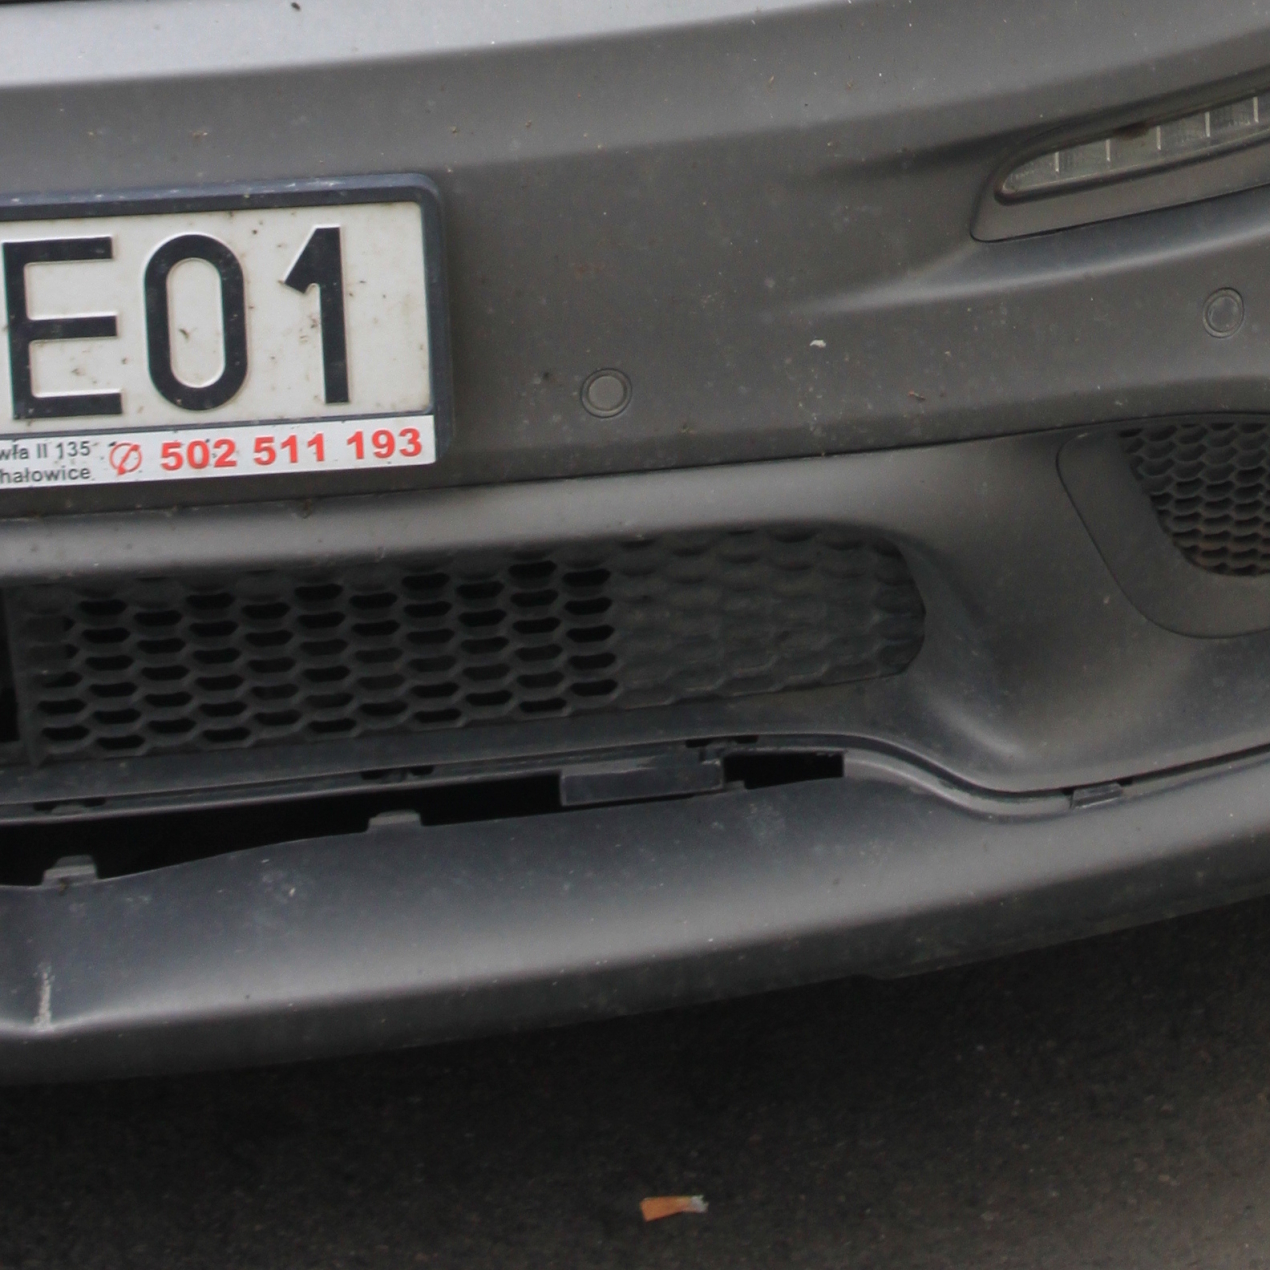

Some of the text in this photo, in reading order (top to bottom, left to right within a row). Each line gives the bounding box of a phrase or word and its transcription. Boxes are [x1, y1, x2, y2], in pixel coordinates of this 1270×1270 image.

[3, 226, 350, 420] E01
[55, 440, 91, 459] 135
[159, 428, 422, 471] 502 511 193
